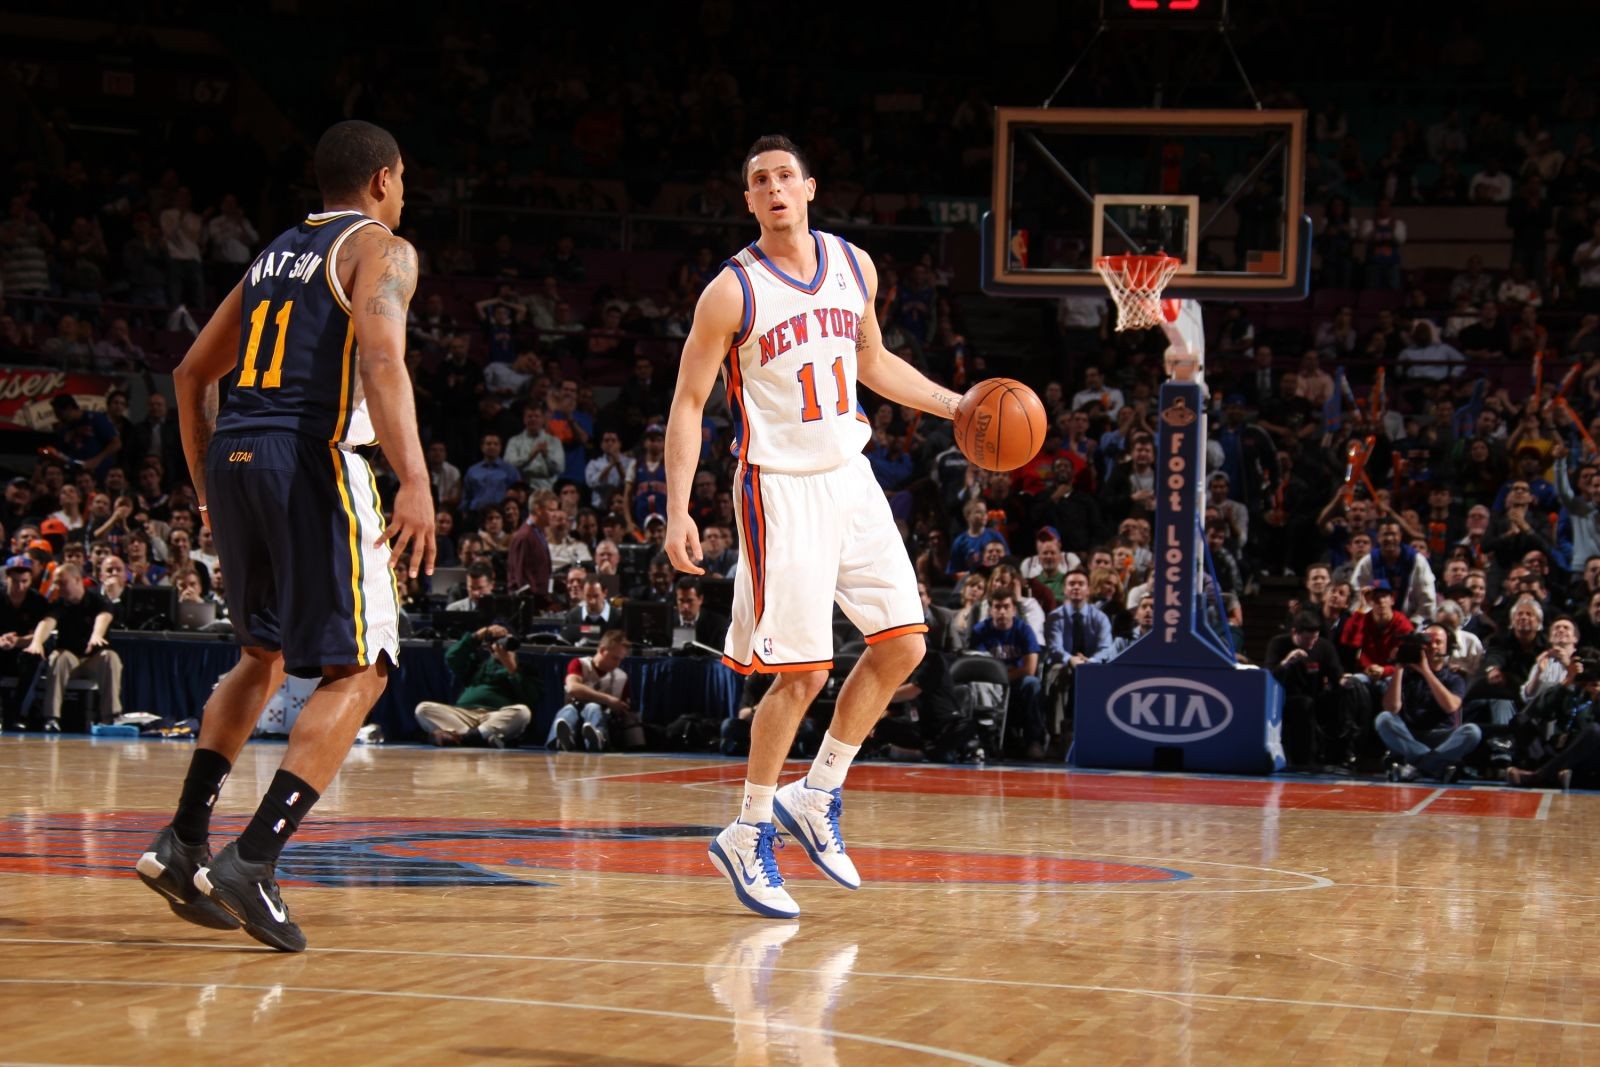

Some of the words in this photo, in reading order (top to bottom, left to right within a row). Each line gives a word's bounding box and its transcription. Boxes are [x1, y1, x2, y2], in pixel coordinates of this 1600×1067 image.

[193, 79, 229, 104] 67
[251, 251, 322, 287] WATSON
[237, 300, 294, 389] 11
[759, 311, 809, 367] NEW
[796, 355, 850, 423] 11
[229, 451, 253, 463] UTAH
[1164, 525, 1183, 643] Locker
[1130, 692, 1213, 729] KIA
